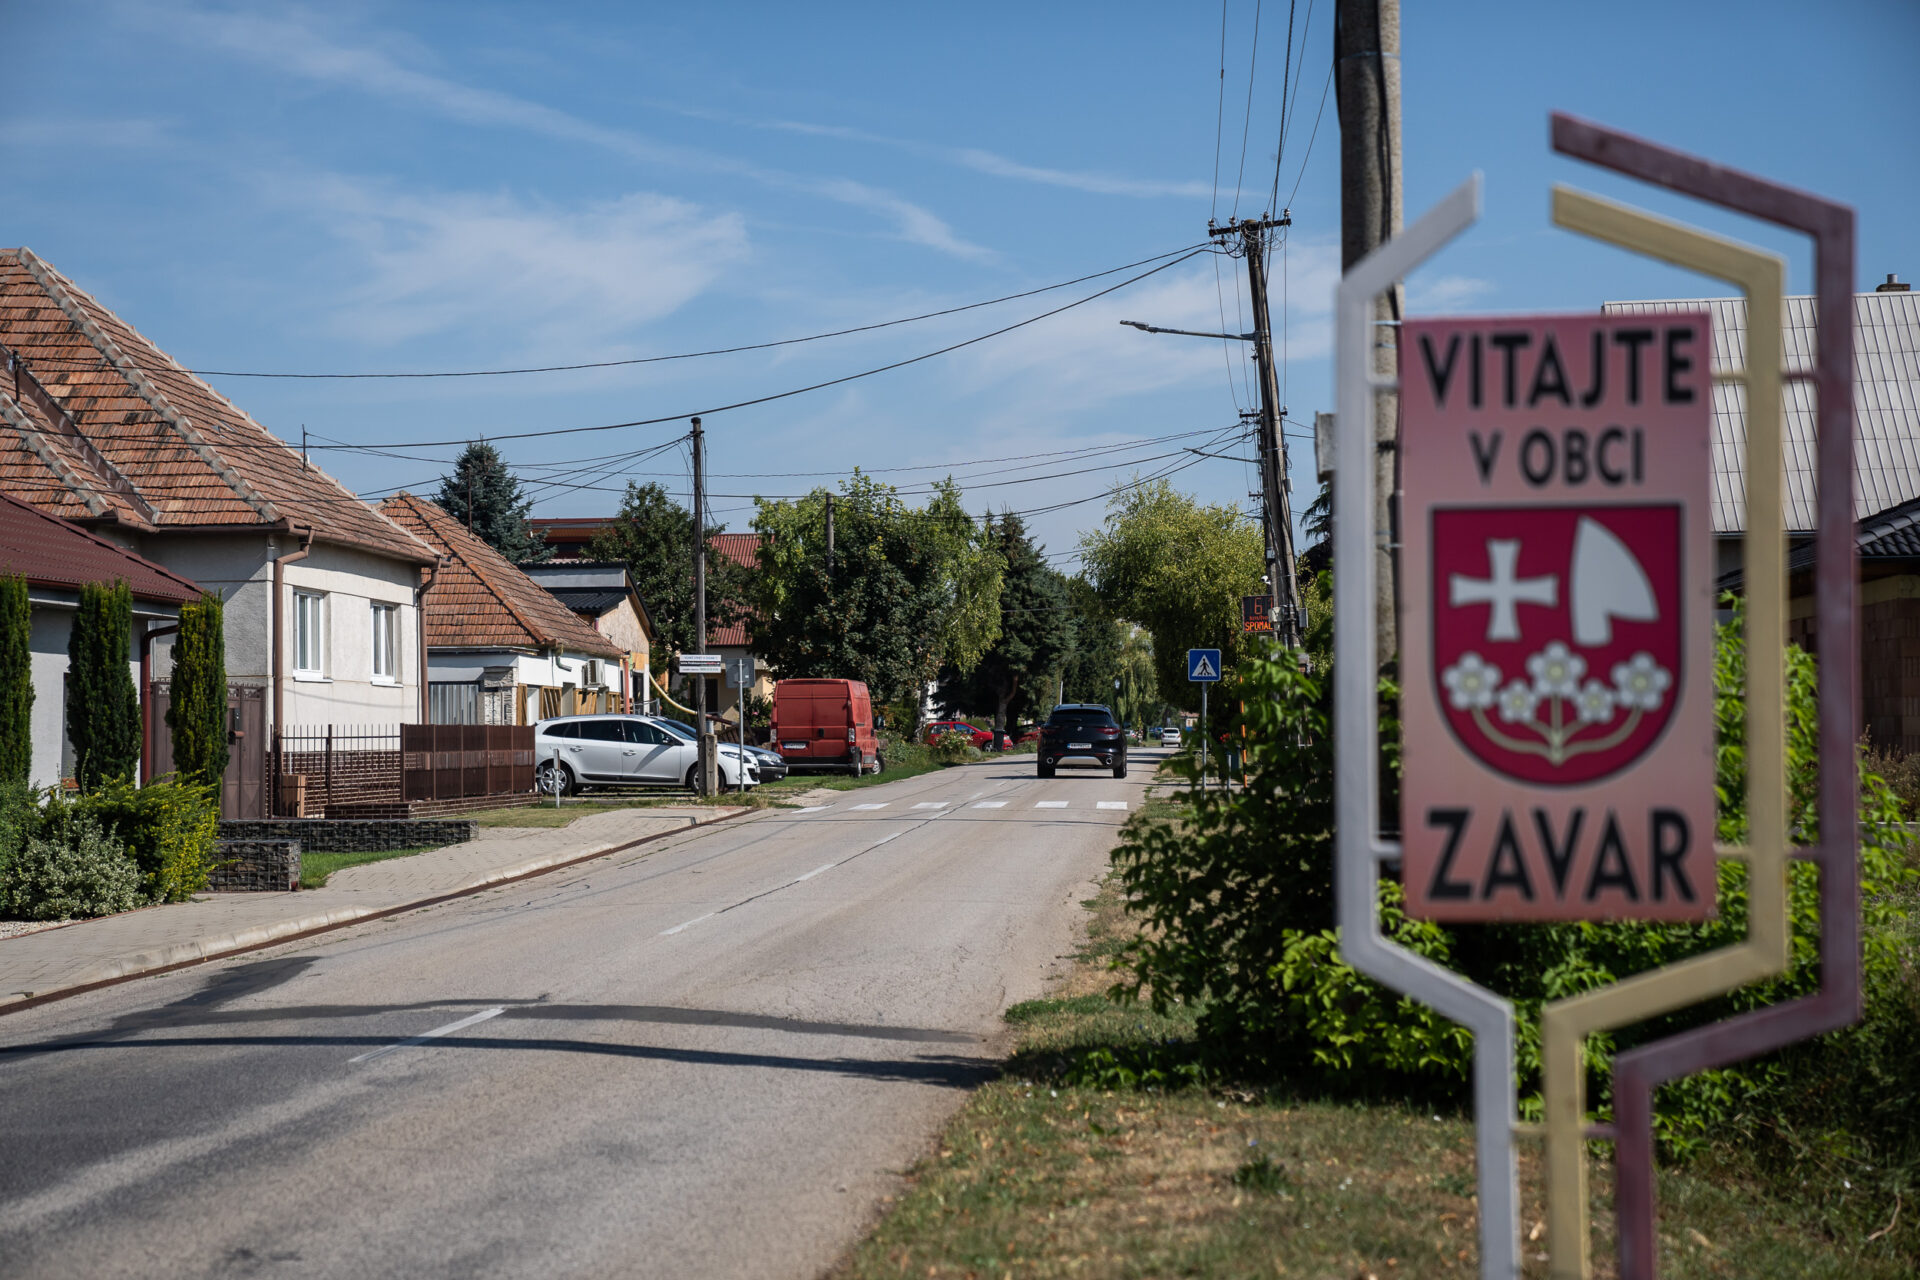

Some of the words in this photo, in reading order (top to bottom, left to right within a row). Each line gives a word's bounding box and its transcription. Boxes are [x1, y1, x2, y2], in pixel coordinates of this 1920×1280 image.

[1418, 326, 1697, 409] VITAJTE
[1469, 430, 1502, 487] V
[1519, 426, 1645, 488] OBCI
[1426, 807, 1698, 903] ZAVAR
